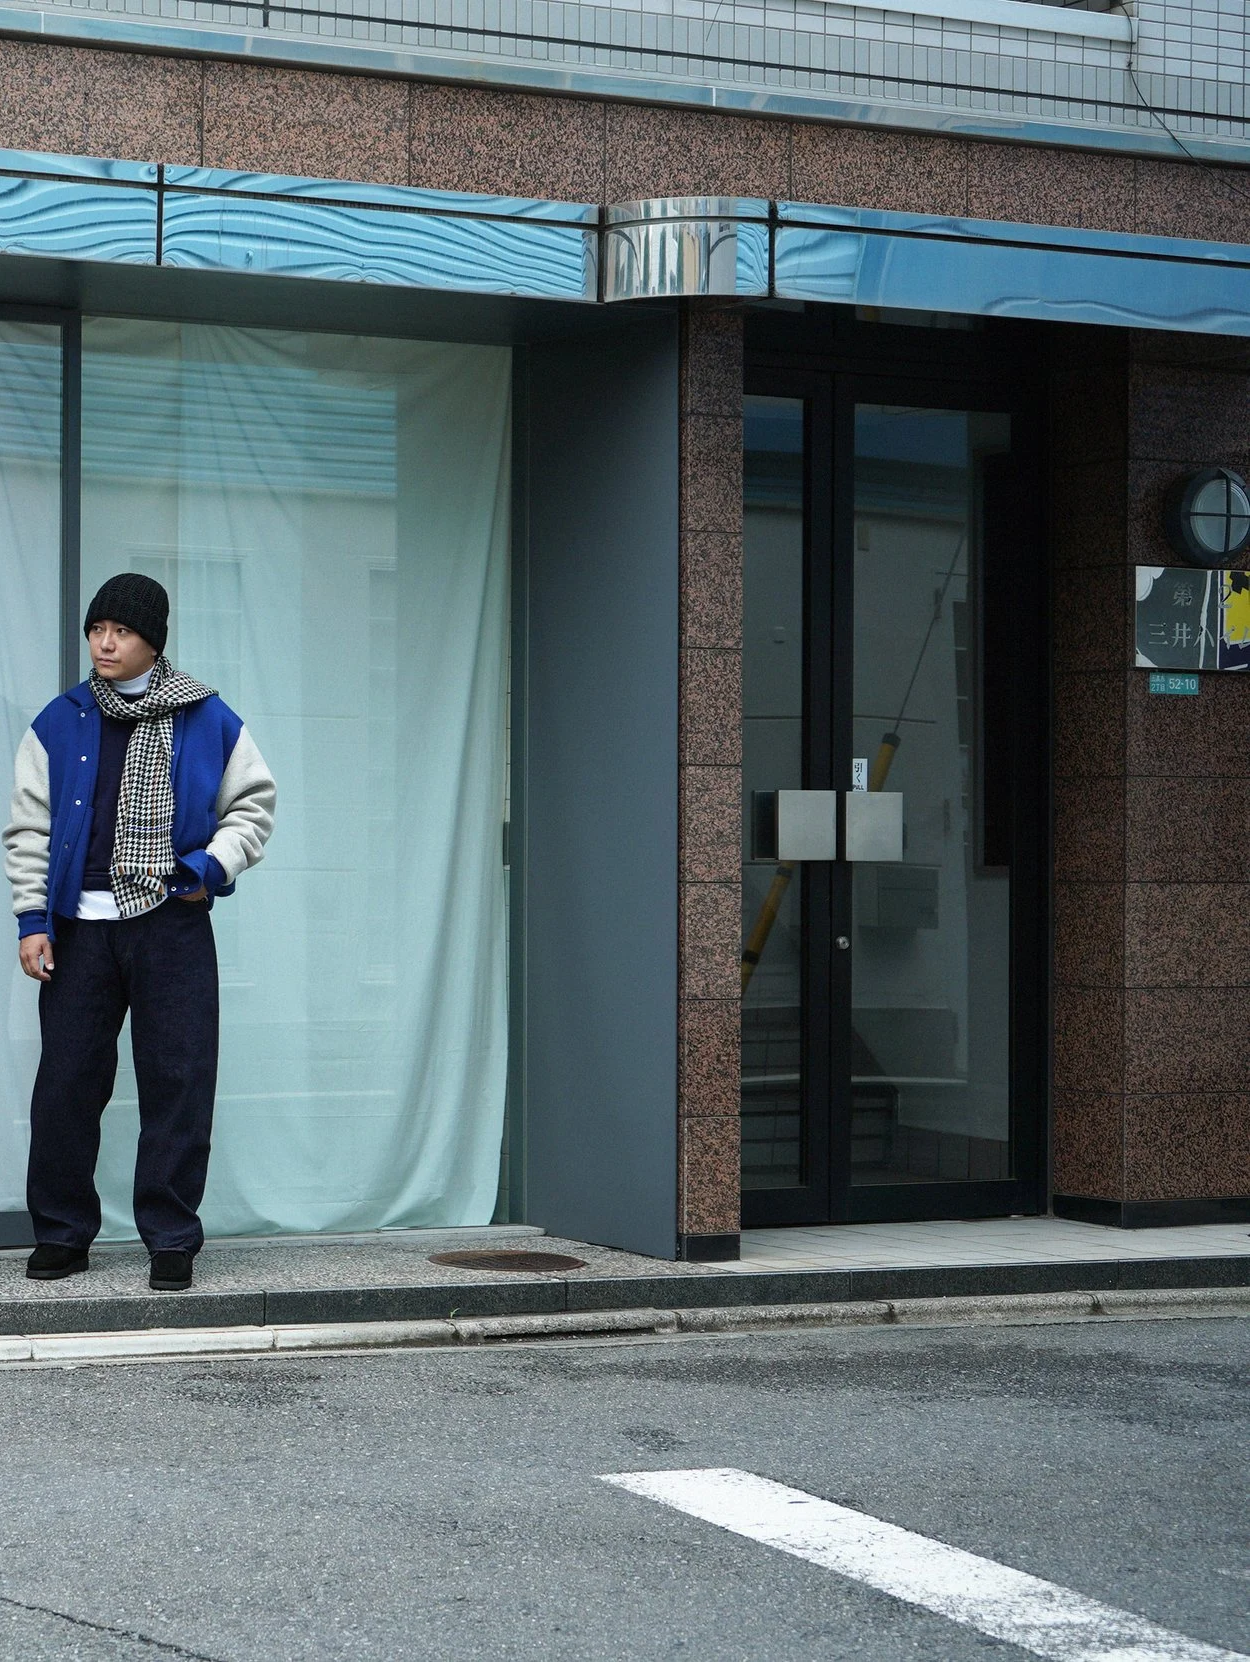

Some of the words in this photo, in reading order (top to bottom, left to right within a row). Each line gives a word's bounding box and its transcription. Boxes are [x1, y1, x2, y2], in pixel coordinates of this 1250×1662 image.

[1172, 582, 1193, 606] 第
[1218, 584, 1232, 609] 2
[1168, 678, 1197, 690] 52-10
[854, 762, 863, 783] 引く
